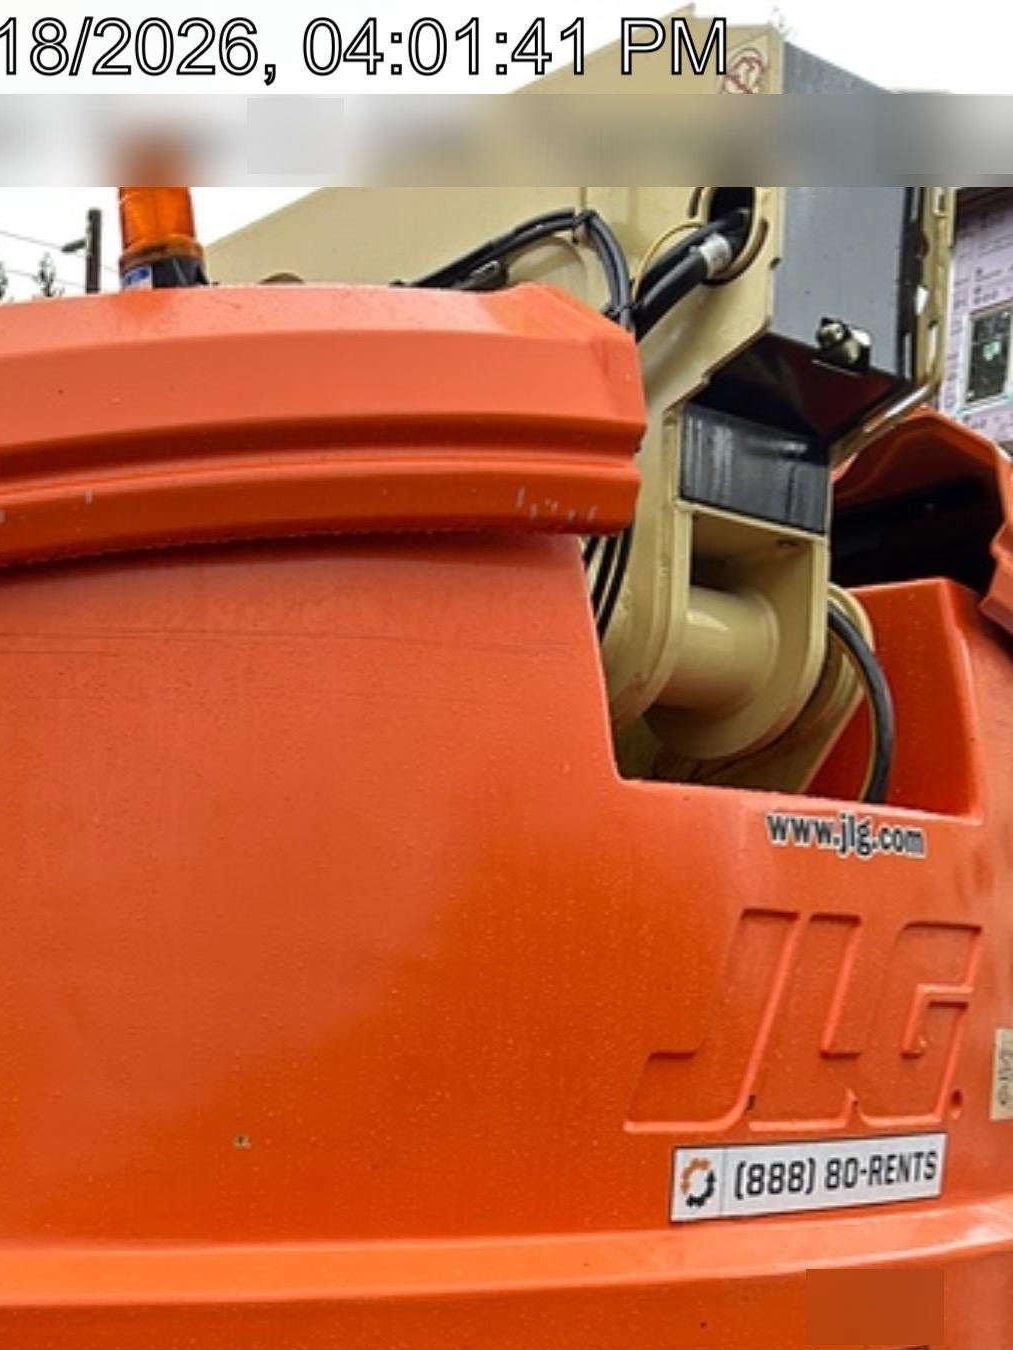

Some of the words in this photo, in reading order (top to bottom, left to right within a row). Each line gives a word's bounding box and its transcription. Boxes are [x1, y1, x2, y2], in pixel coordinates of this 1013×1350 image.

[767, 812, 926, 858] www.jlg.com
[624, 908, 982, 1134] JLG
[734, 1157, 815, 1200] (888)
[824, 1151, 937, 1191] 80-RENTS
